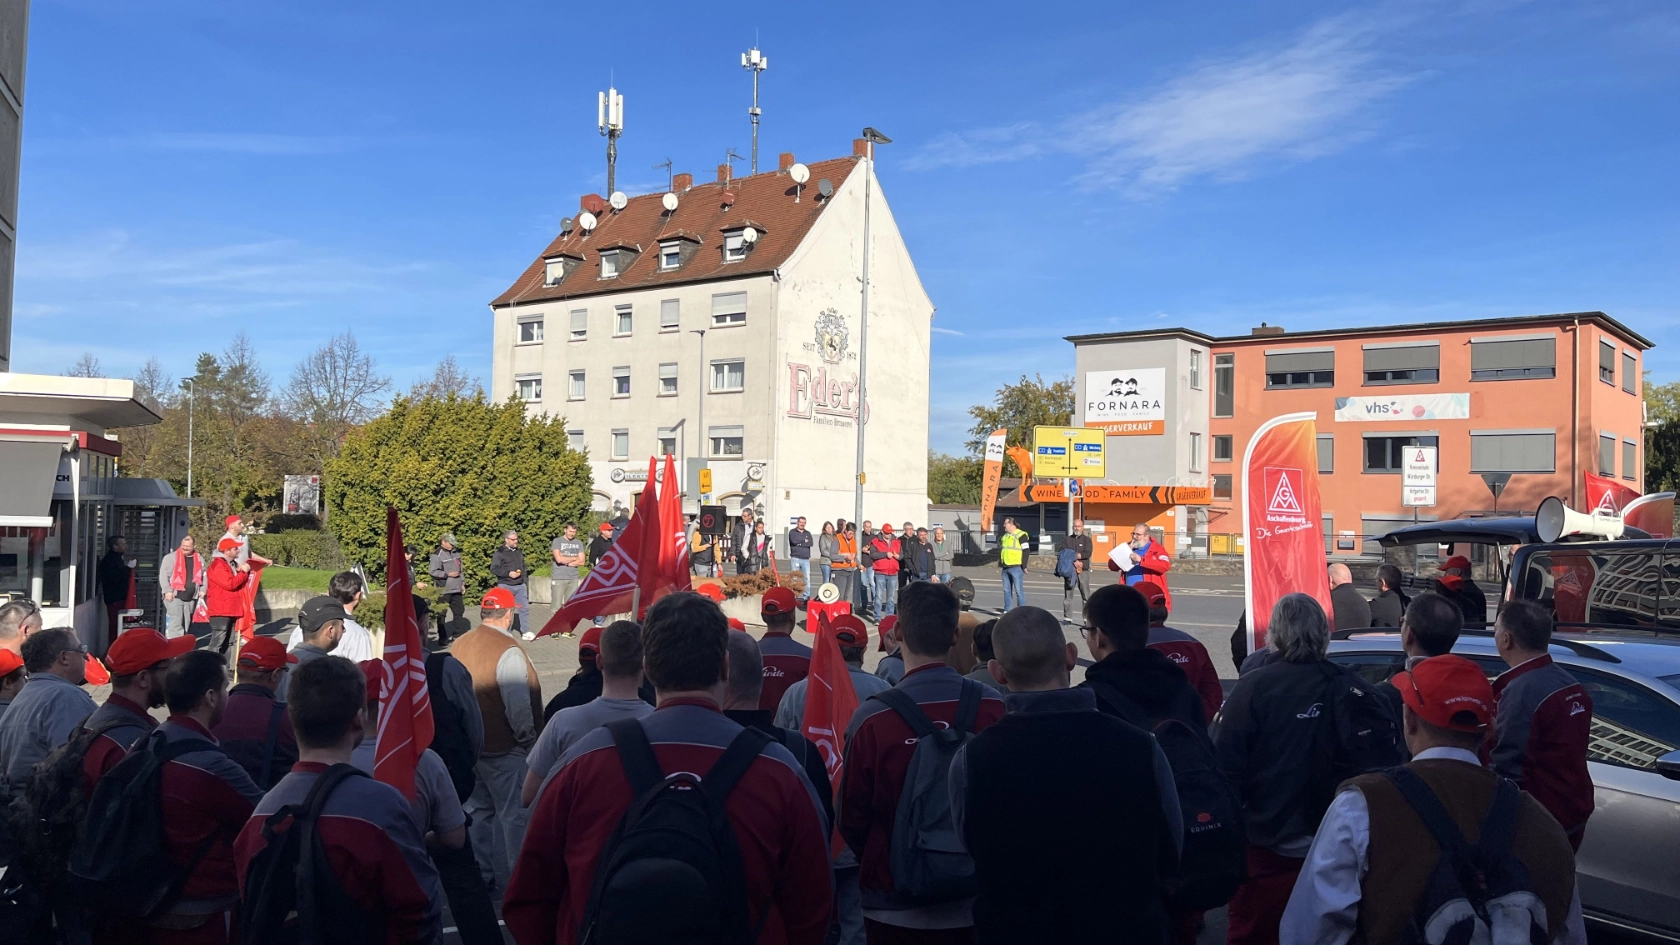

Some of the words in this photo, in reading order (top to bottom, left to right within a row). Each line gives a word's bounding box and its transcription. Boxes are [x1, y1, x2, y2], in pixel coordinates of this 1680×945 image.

[803, 342, 815, 352] SEIT
[787, 362, 870, 426] Eder's
[1088, 400, 1161, 411] FORNARA
[1365, 402, 1389, 414] vhs
[1036, 490, 1062, 498] WINE
[1109, 491, 1147, 499] FAMILY
[1266, 515, 1306, 525] Aschaffenburg
[1256, 526, 1273, 539] Die
[1190, 822, 1222, 833] EQUINIX
